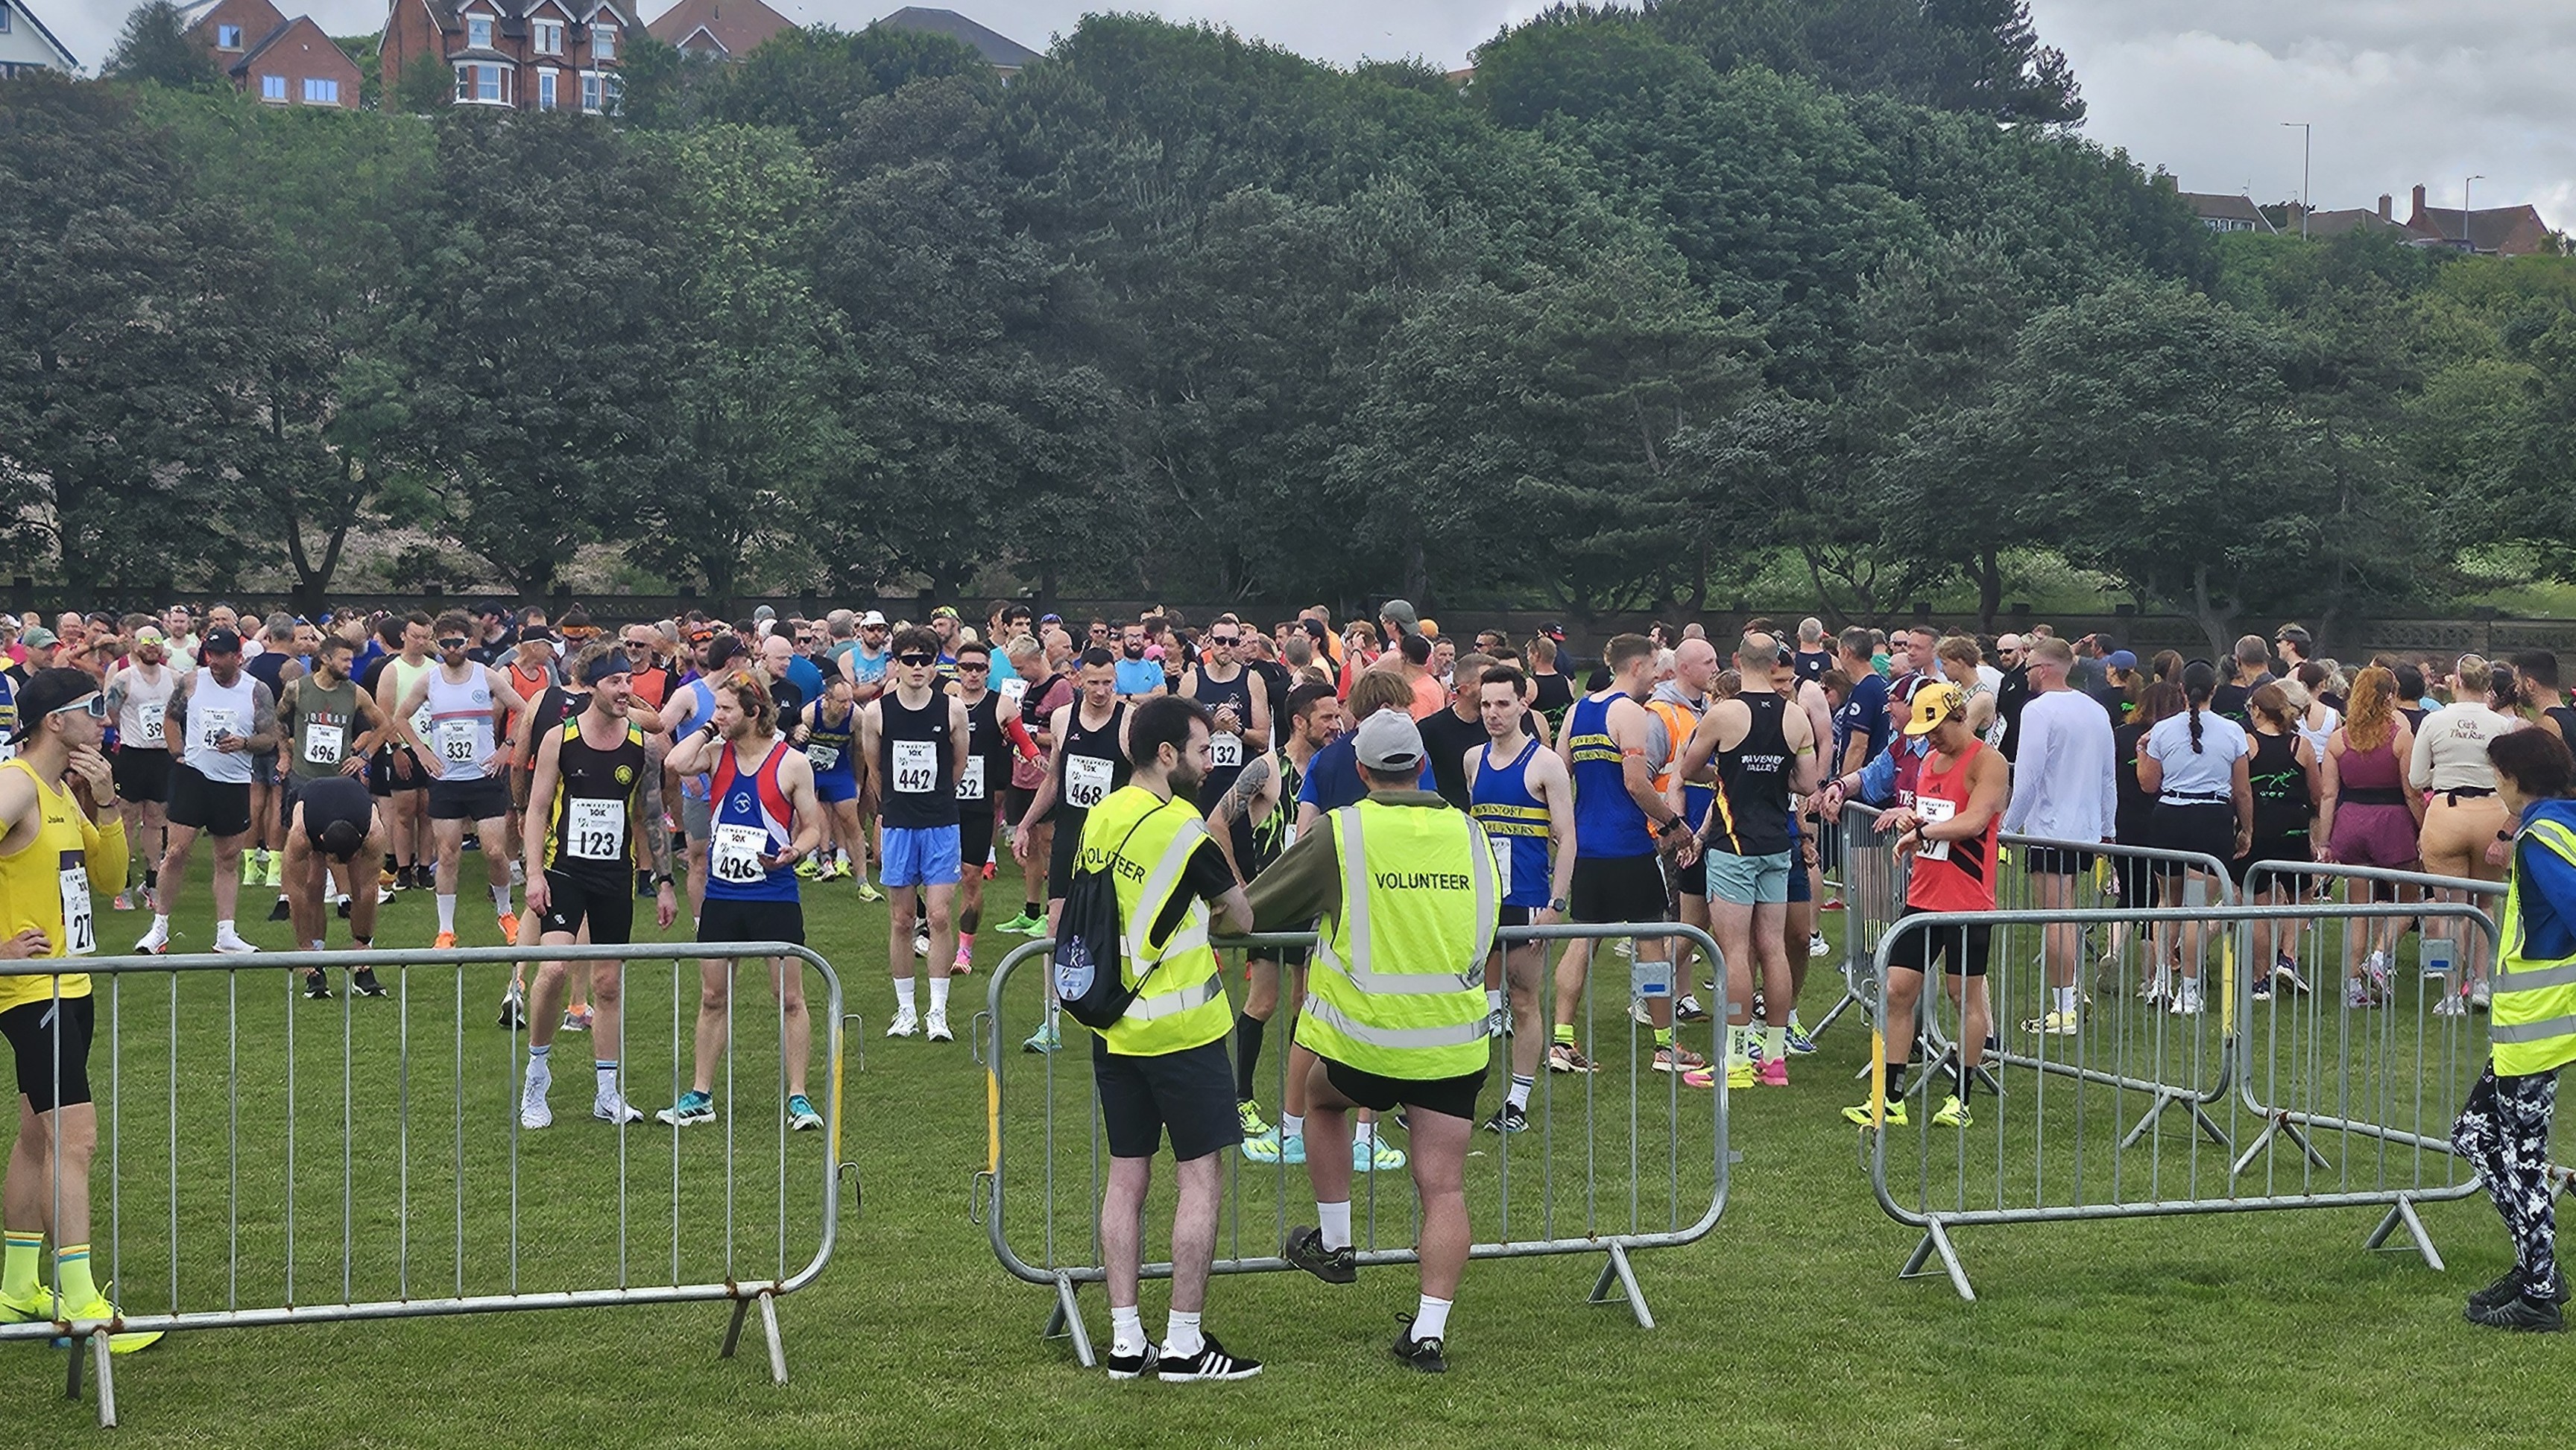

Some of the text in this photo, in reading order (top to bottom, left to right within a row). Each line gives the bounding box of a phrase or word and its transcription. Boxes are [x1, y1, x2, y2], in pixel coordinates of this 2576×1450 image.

[311, 744, 335, 762] 496
[446, 741, 473, 759] 332
[1211, 746, 1235, 764] 132
[899, 769, 931, 790] 442
[1072, 784, 1102, 807] 468
[580, 832, 615, 856] 123
[719, 856, 757, 879] 426
[1375, 873, 1471, 890] VOLUNTEER
